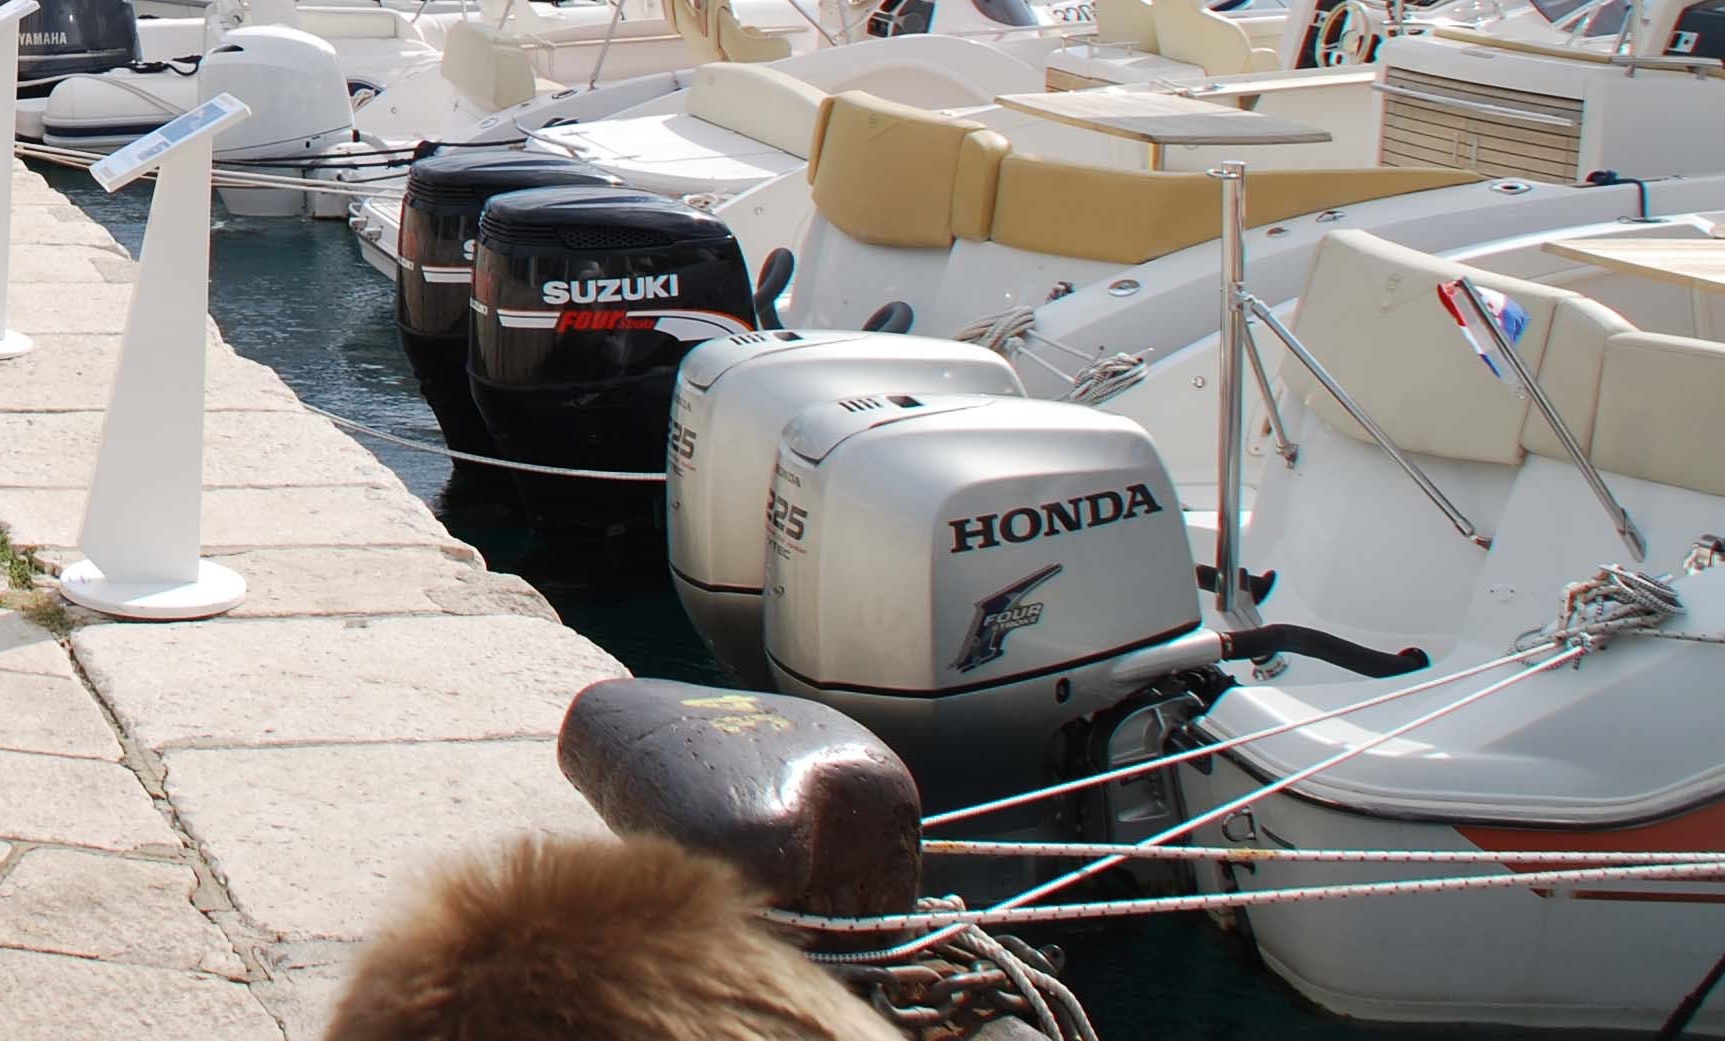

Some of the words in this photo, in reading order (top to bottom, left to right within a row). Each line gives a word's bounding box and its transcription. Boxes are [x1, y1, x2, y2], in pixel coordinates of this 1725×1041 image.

[18, 31, 68, 47] YAMAHA
[542, 273, 679, 305] SUZUKI
[947, 483, 1164, 553] HONDA
[983, 603, 1043, 627] FOUR
